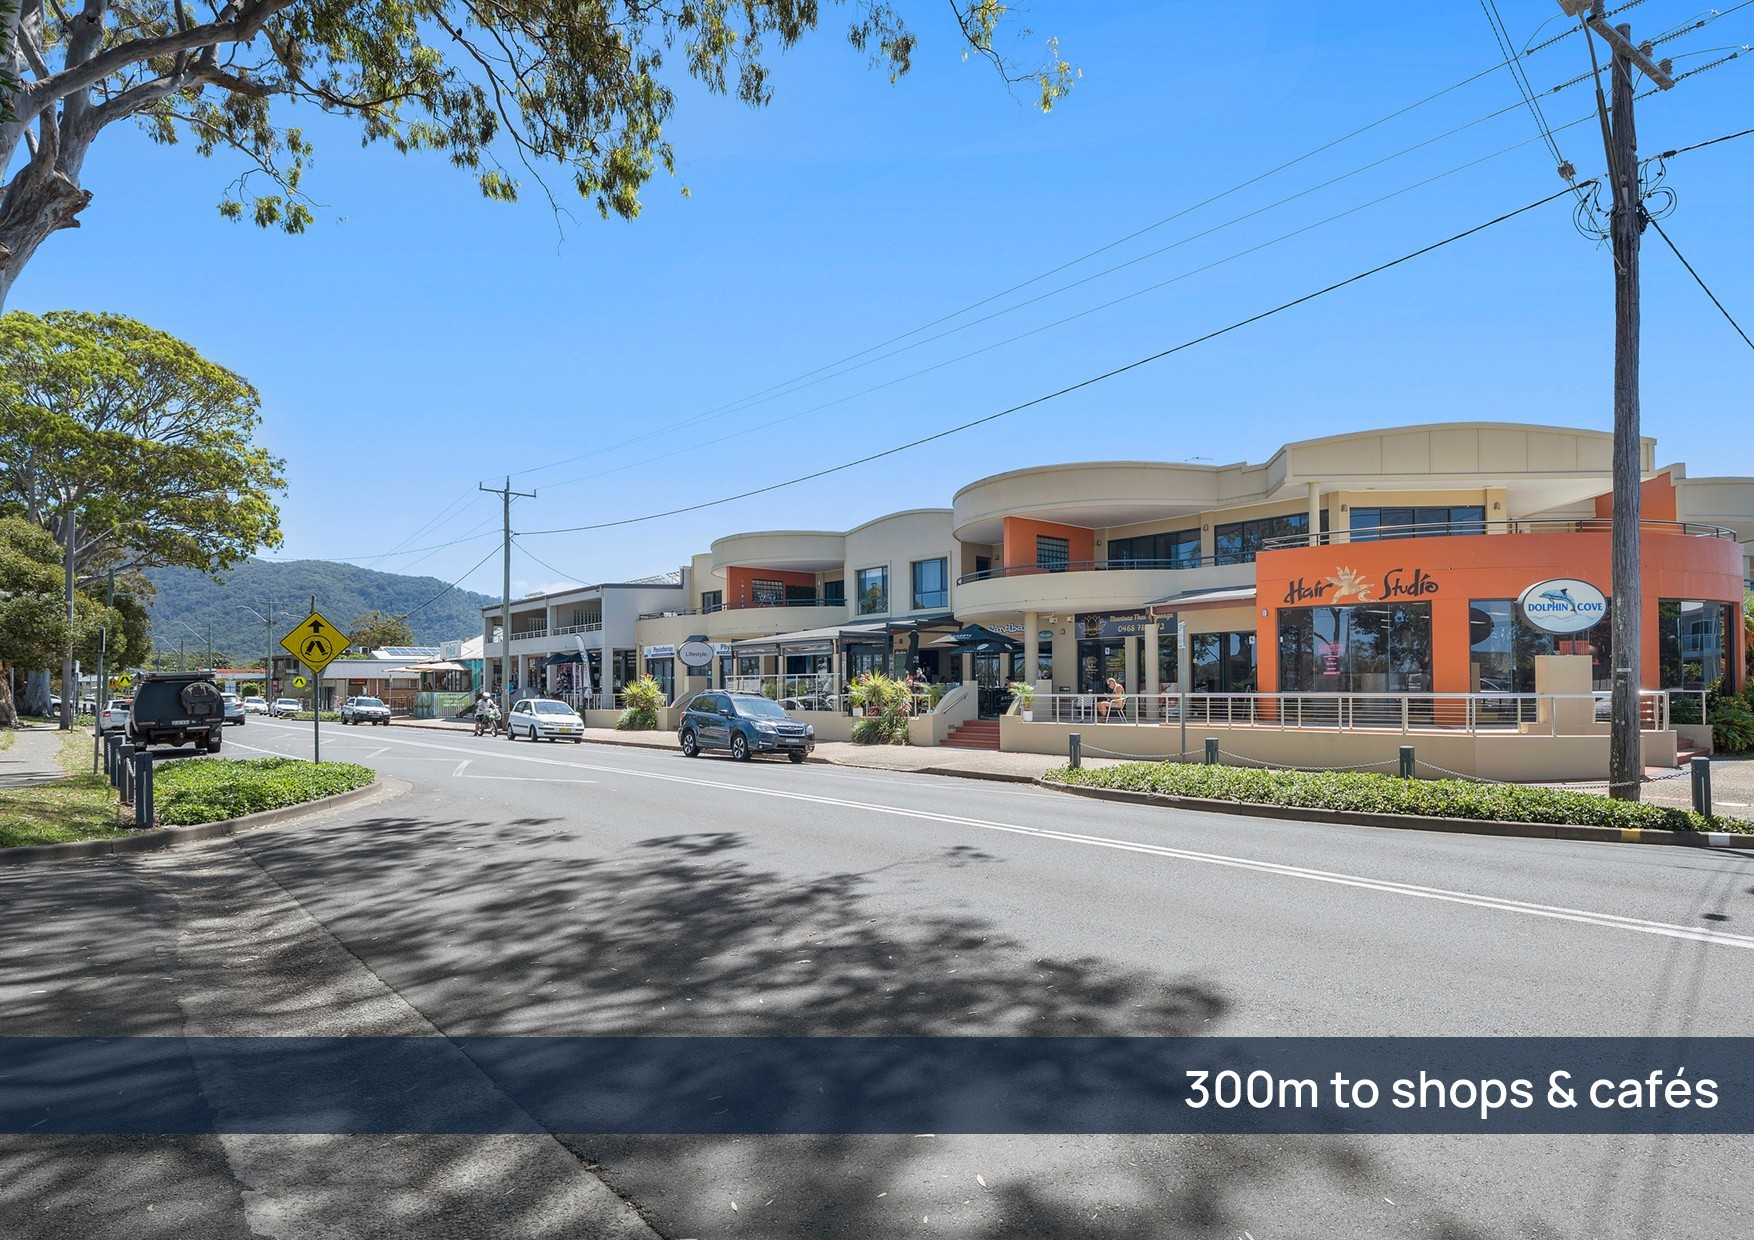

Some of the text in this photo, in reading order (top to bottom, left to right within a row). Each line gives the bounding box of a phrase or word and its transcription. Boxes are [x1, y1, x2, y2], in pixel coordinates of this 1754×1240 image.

[1284, 568, 1439, 604] Hair Studio
[1528, 602, 1603, 611] DOLPHIN COVE
[987, 623, 1025, 633] Sandba
